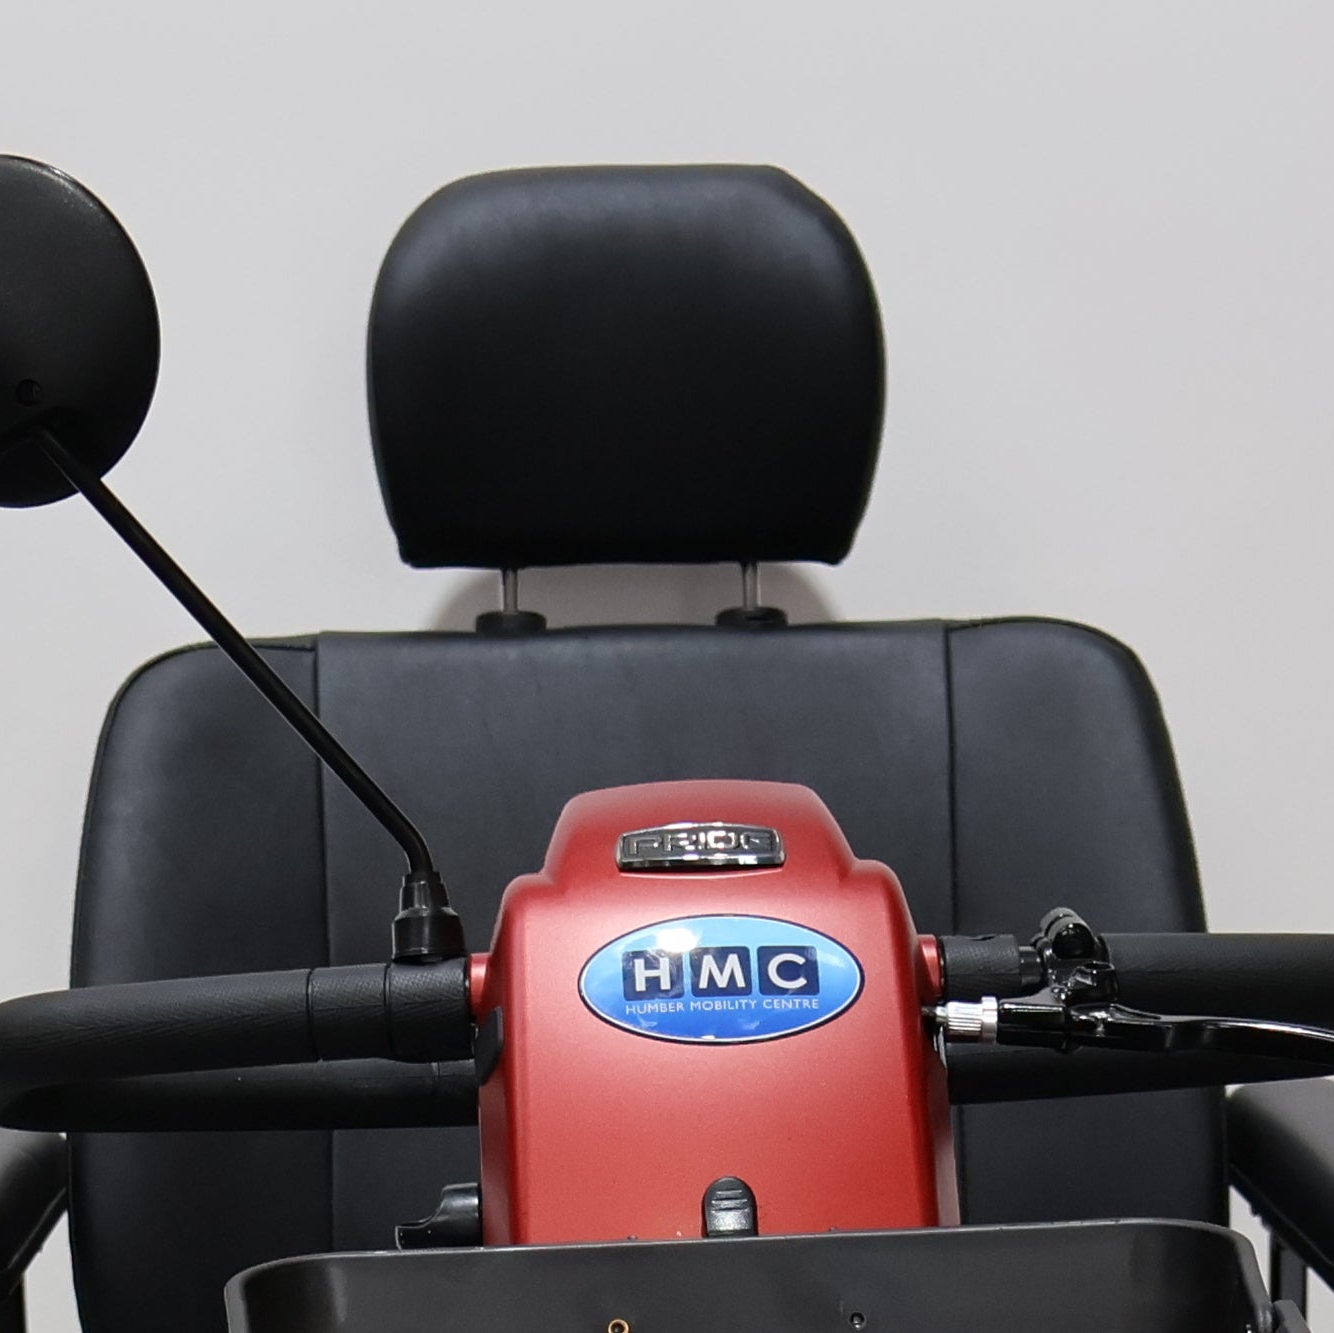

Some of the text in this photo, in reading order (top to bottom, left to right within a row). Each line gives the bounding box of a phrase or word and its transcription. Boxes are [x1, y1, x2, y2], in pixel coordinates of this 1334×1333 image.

[625, 998, 819, 1015] HUMBER MOBILITY CENTRE
